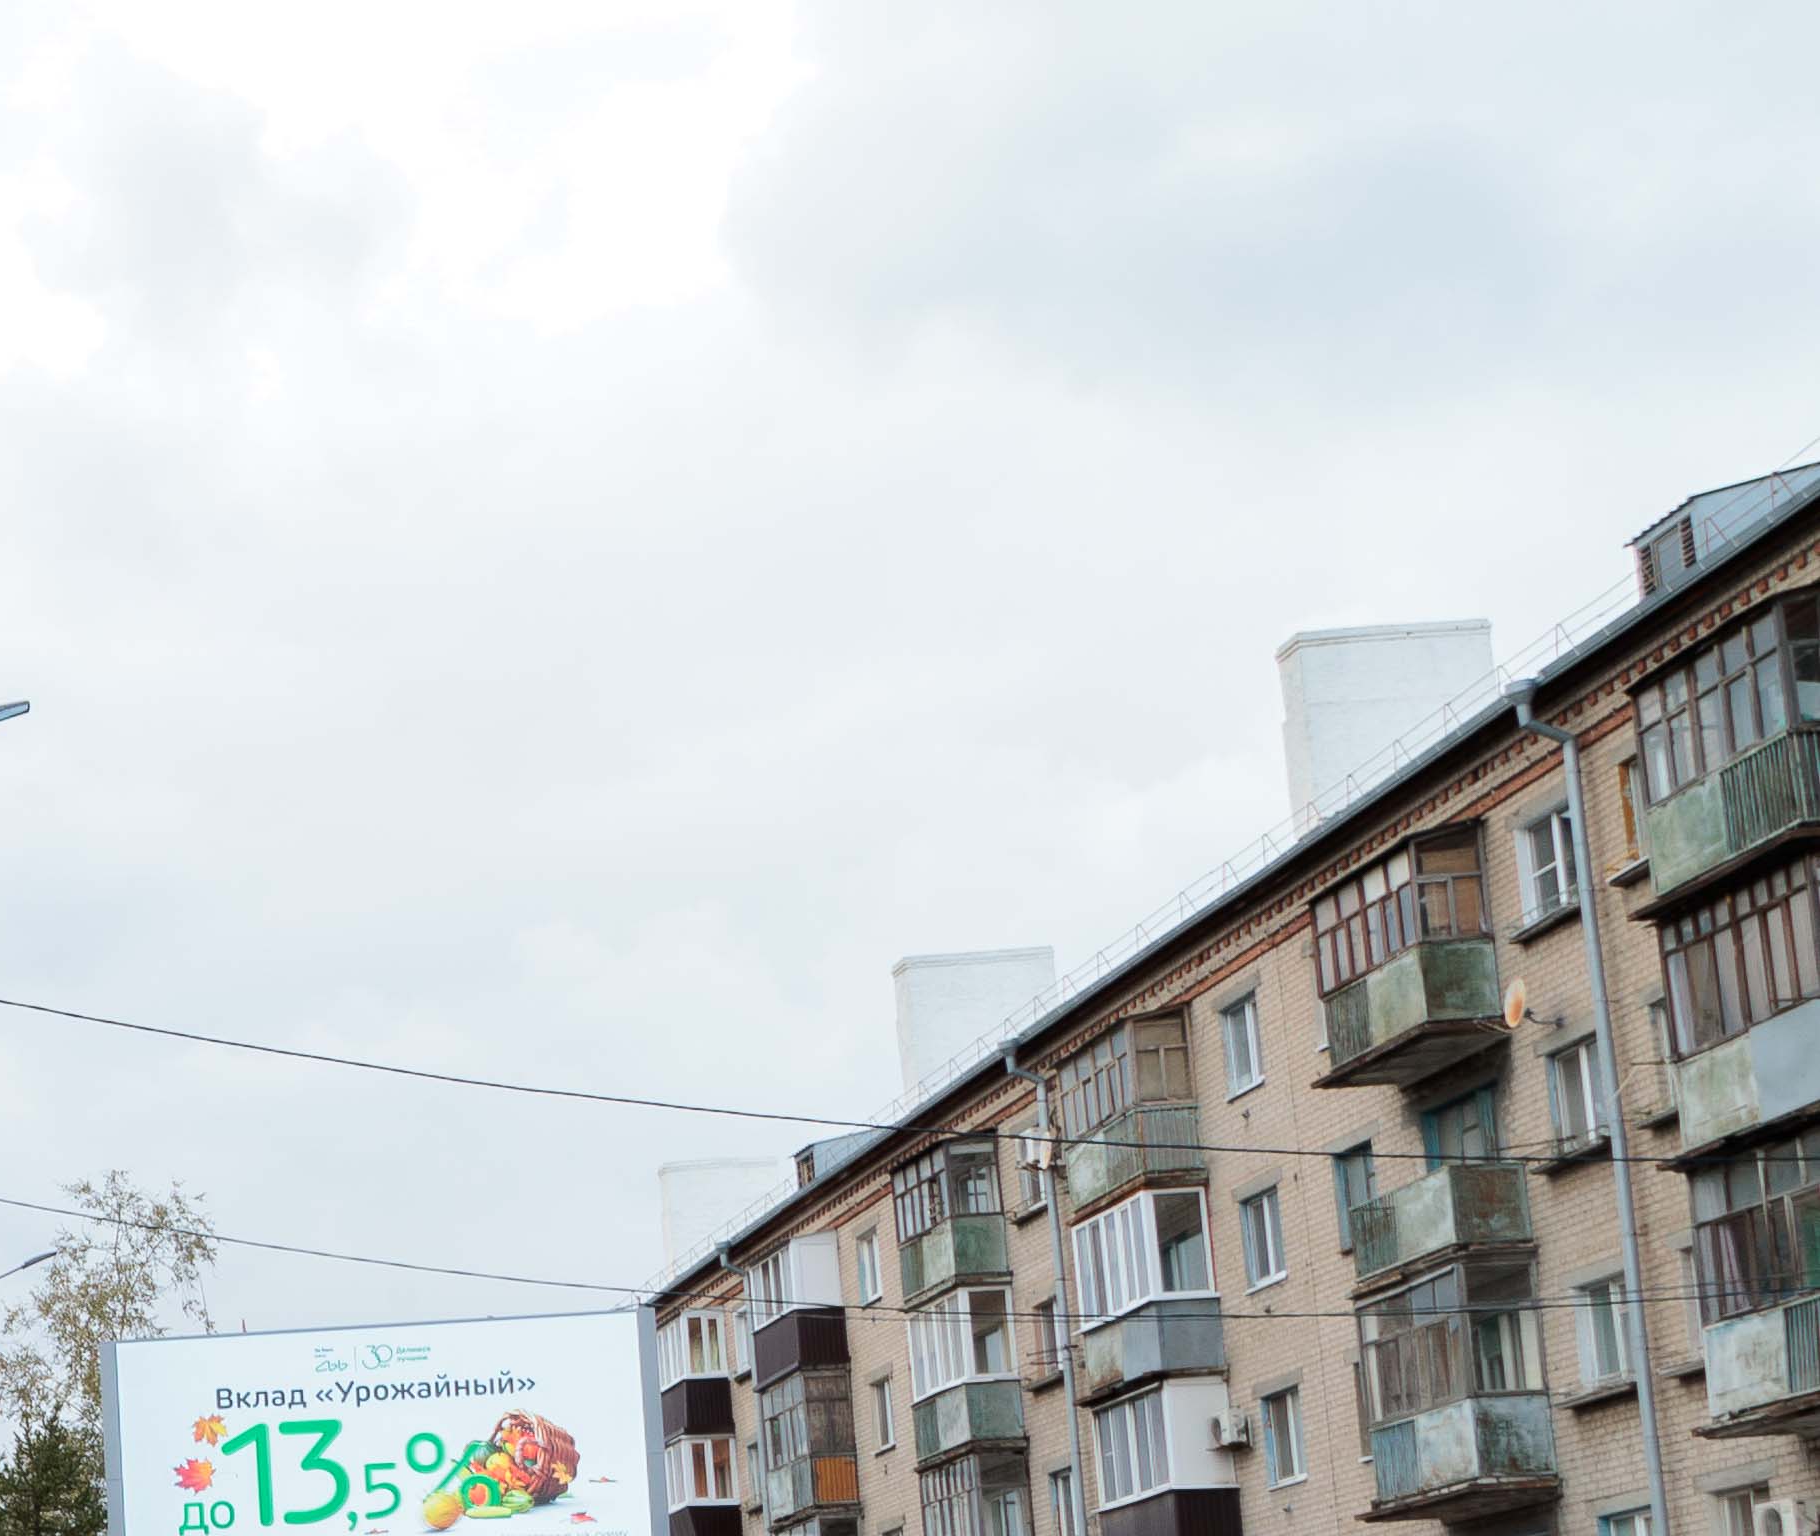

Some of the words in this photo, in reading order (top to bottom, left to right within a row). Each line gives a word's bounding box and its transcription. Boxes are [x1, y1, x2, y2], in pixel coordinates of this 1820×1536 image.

[216, 1387, 306, 1410] Вклад
[316, 1370, 536, 1407] «Урожайный»
[179, 1500, 235, 1536] до
[220, 1418, 503, 1532] 13,5%
